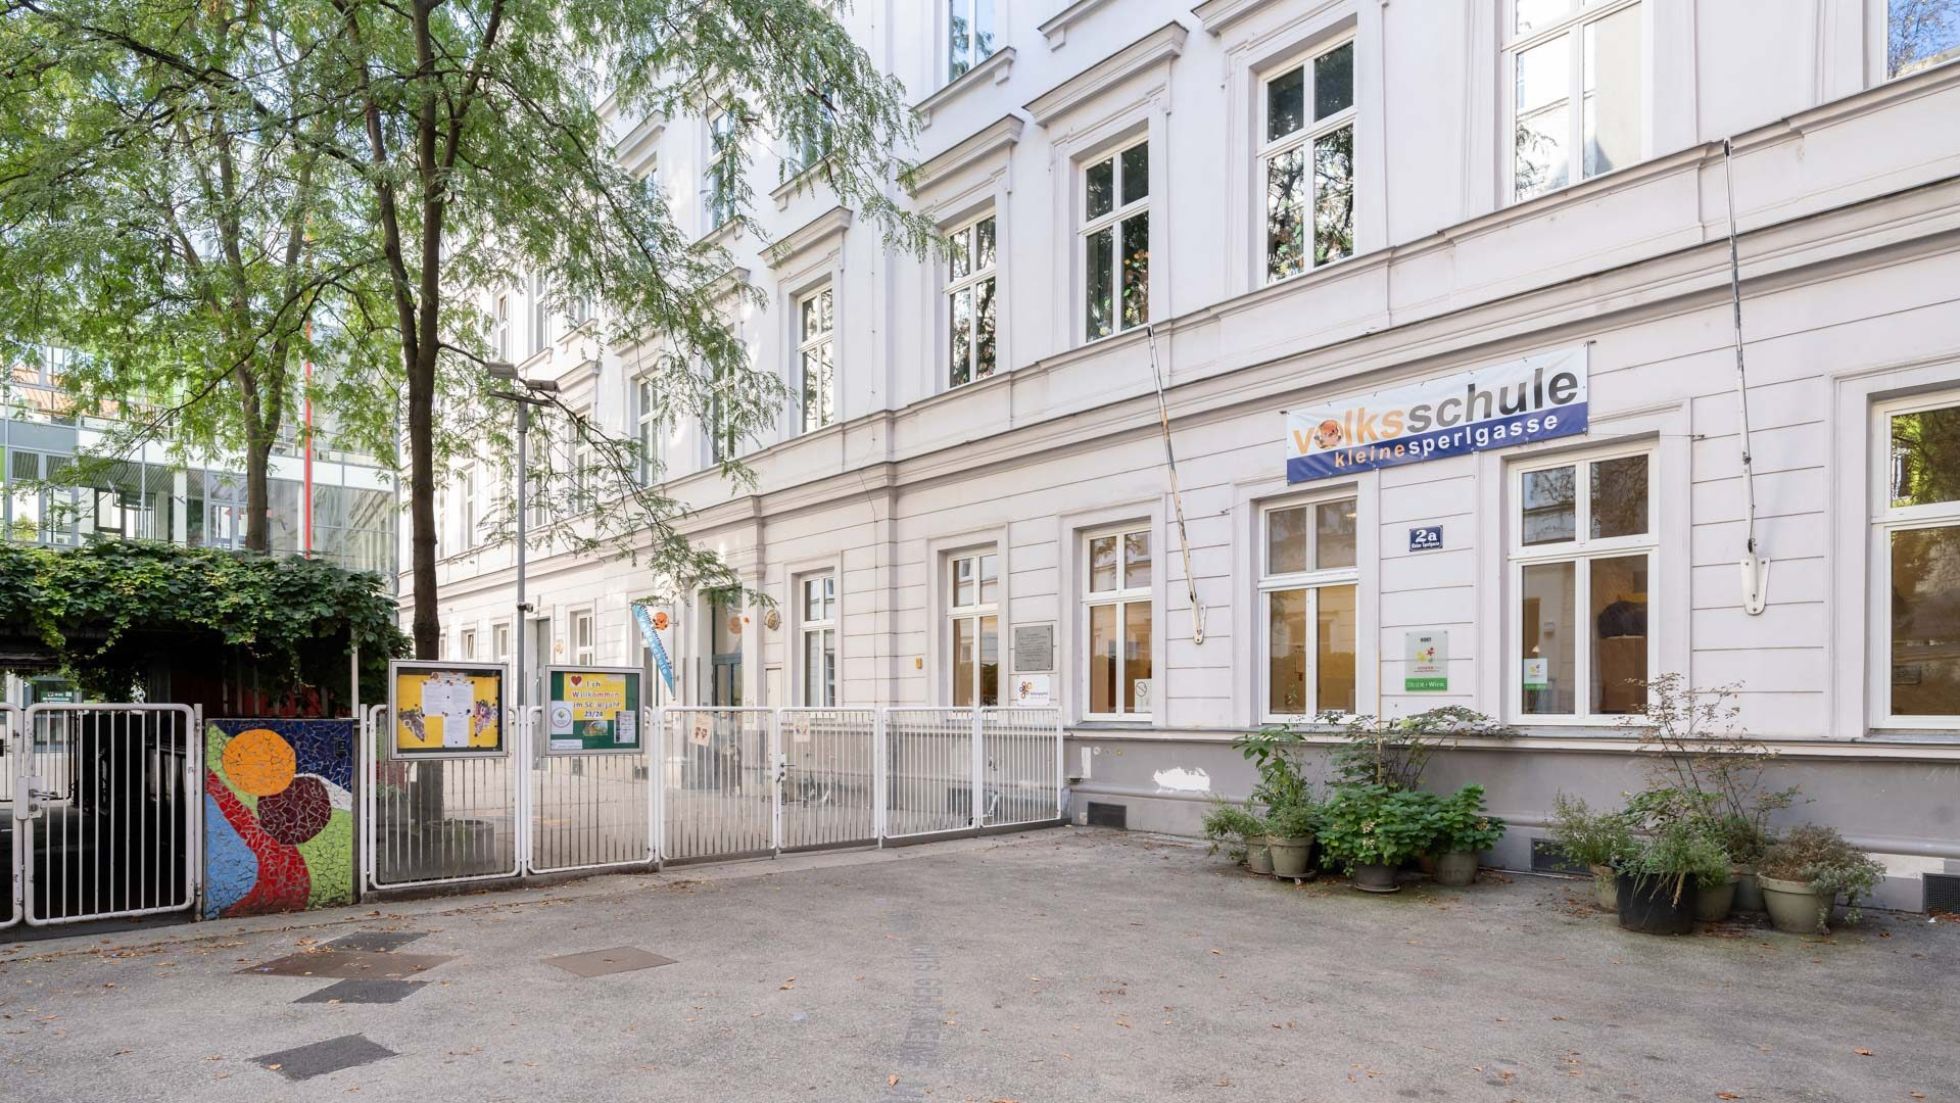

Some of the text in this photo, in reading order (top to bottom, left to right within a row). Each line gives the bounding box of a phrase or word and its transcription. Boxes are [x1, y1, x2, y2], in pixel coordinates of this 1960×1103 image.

[1293, 367, 1578, 455] volksschule
[1415, 529, 1437, 543] 2a
[585, 701, 620, 709] Sculjahr
